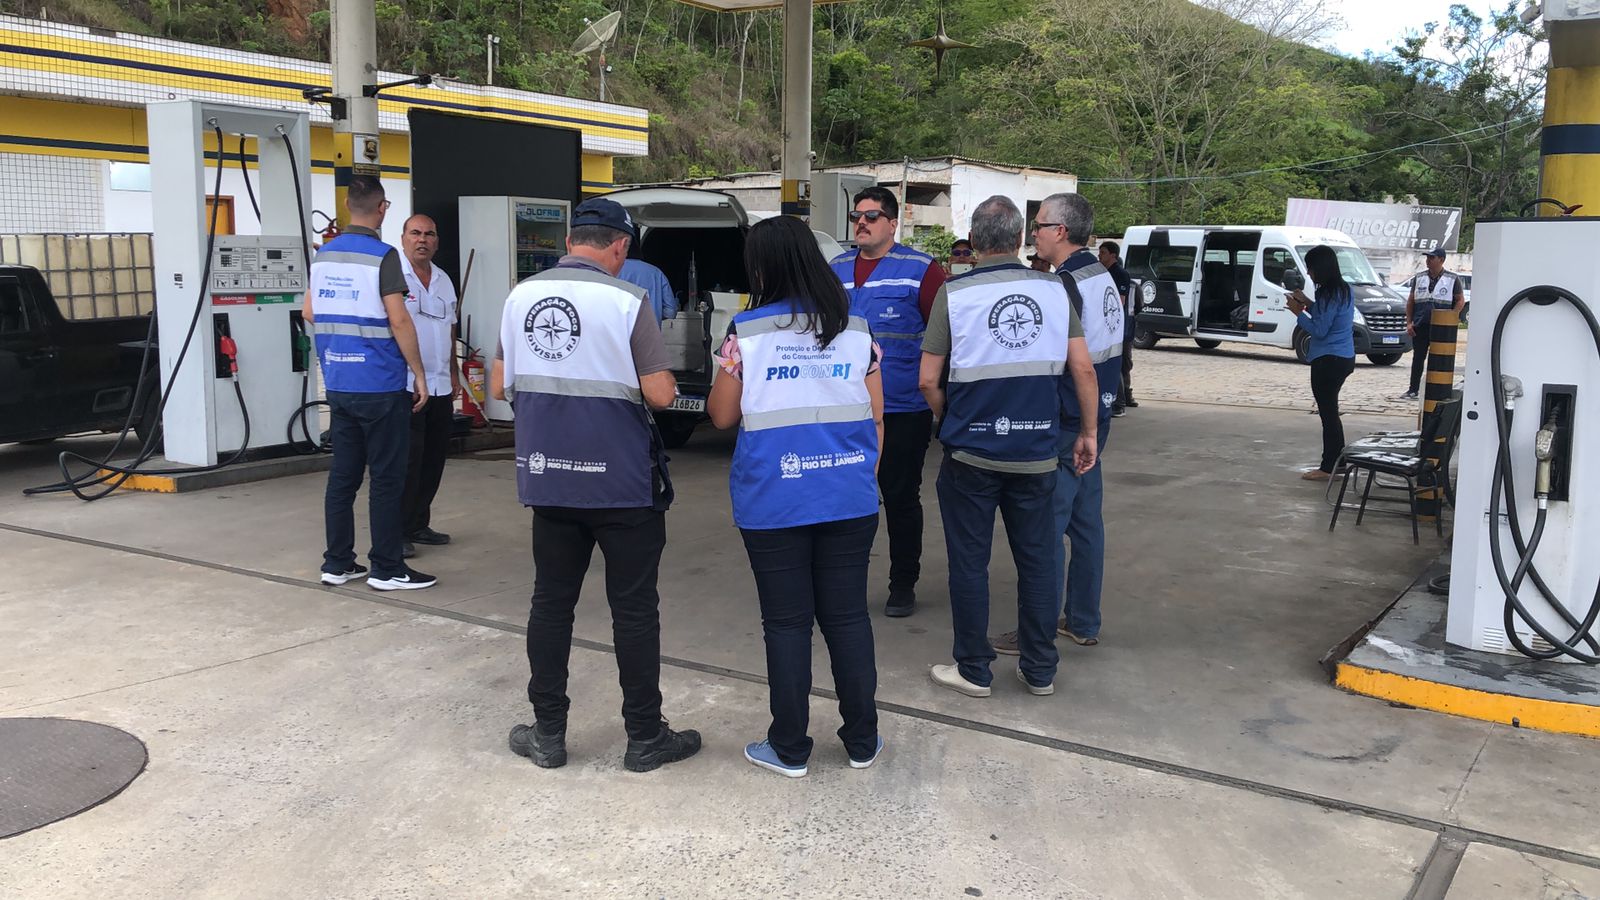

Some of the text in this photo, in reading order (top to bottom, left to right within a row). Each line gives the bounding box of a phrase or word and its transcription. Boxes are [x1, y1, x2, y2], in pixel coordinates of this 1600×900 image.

[1379, 237, 1438, 249] CENTER
[526, 297, 578, 331] OPERAÇÃO FOCO
[1026, 300, 1041, 321] FOCO
[992, 326, 1041, 349] DIVISAS RJ
[527, 334, 563, 360] DIVISAS
[801, 453, 833, 462] GOVERNO
[802, 460, 820, 470] RIO
[820, 459, 833, 468] DE
[562, 463, 572, 471] DE
[572, 465, 607, 473] JANEIRO
